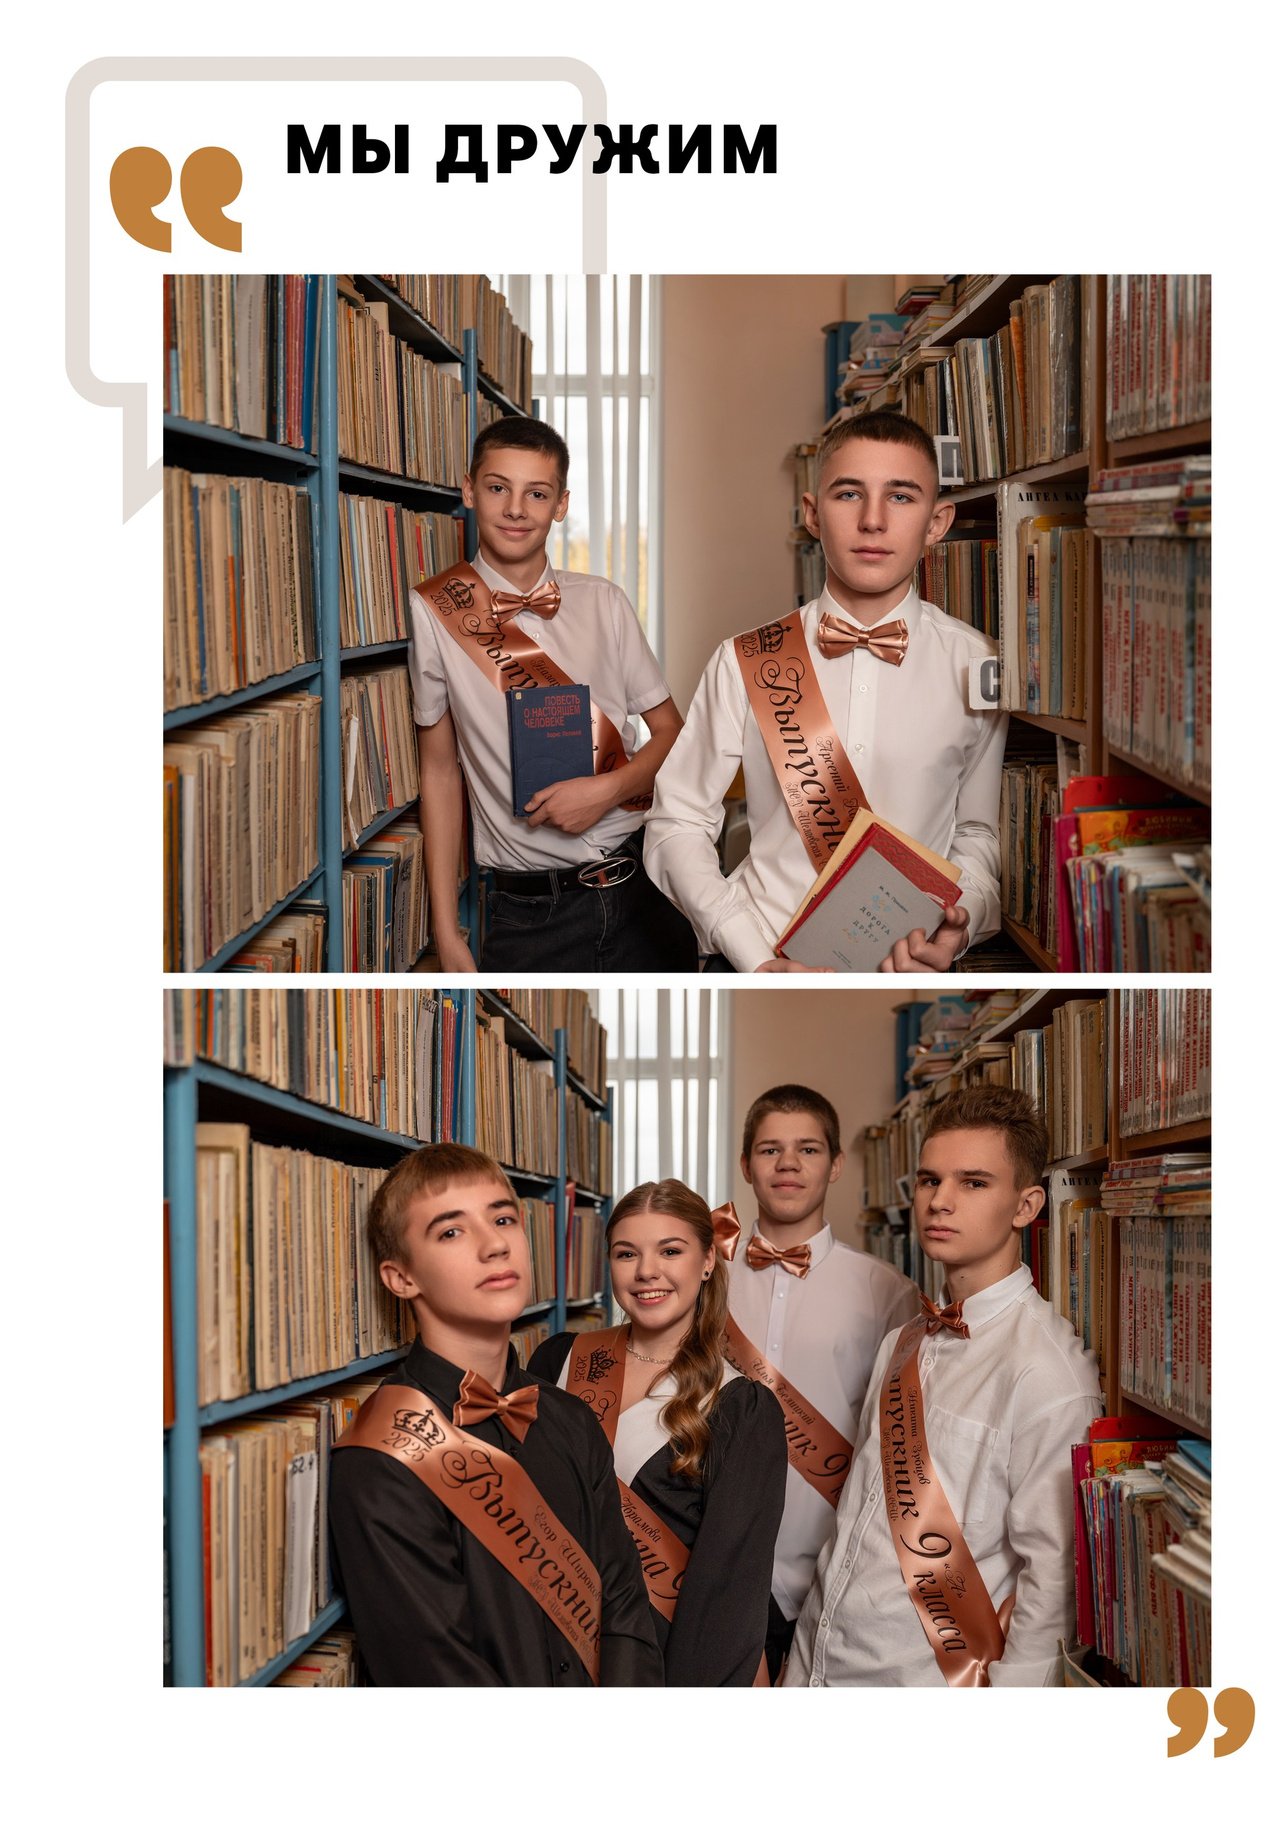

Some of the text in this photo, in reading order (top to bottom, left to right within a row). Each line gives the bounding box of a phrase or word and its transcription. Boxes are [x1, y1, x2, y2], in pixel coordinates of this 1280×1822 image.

[1017, 492, 1060, 502] АНГЕЛ
[430, 592, 457, 616] 2025
[741, 630, 756, 657] 2025
[530, 657, 560, 686] Назар
[524, 705, 581, 718] О НАСТОЯЩЕМ
[545, 694, 581, 707] ПОВЕСТЬ
[524, 716, 565, 728] ЧЕЛОВЕКЕ
[816, 736, 850, 793] Арсений
[853, 920, 880, 943] ДРУГУ
[860, 906, 891, 935] ДОРОГА
[1061, 1177, 1101, 1187] АНГЕЛ
[1128, 1308, 1134, 1320] НА
[575, 1354, 587, 1382] 2025
[750, 1356, 774, 1385] Илья
[381, 1430, 428, 1462] 2025
[907, 1385, 931, 1485] Никита Зубцов
[808, 1453, 850, 1478] 9
[440, 1439, 601, 1653] Выпускник
[534, 1504, 602, 1601] Егор Широков
[899, 1532, 952, 1559] 9
[912, 1570, 967, 1655] класса
